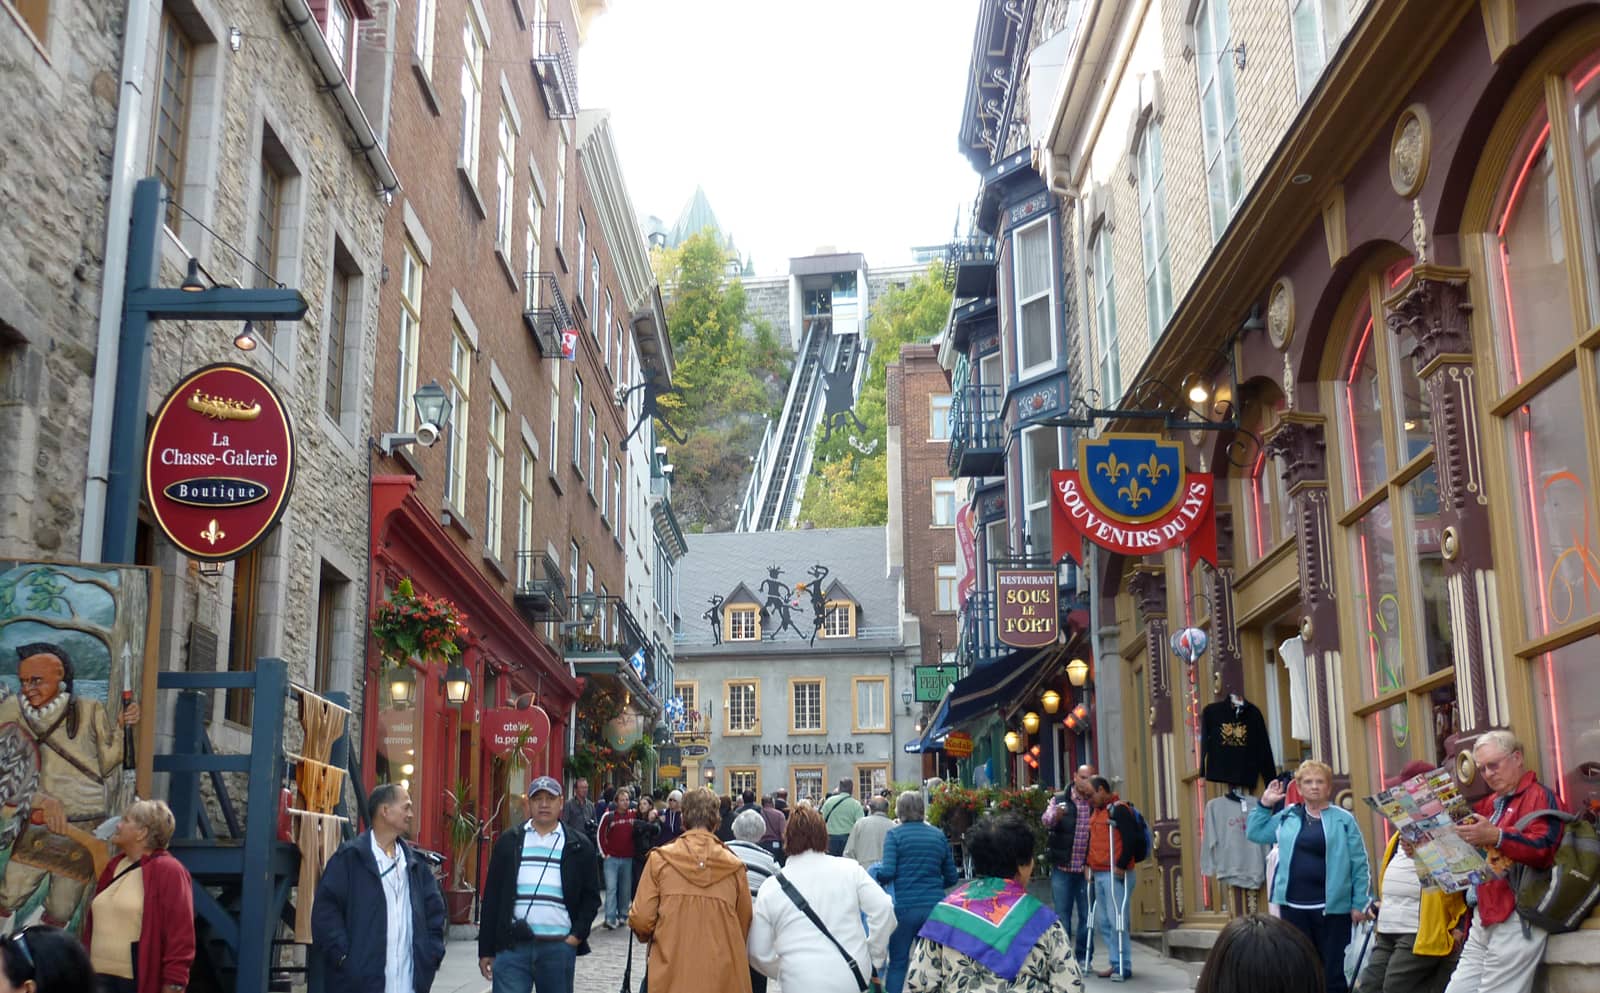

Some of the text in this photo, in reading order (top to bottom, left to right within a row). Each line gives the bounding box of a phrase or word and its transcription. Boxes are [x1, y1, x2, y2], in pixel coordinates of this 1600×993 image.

[212, 432, 230, 447] La
[161, 447, 278, 466] Chasse-Galerie
[179, 484, 255, 500] Boutique
[1058, 479, 1207, 548] SOUVENIRS DU LYS
[1000, 575, 1055, 585] RESTAURANT
[1006, 589, 1051, 605] SOUS
[1022, 605, 1035, 616] LE
[1004, 617, 1054, 633] FORT
[752, 742, 865, 757] FUNICULAIRE
